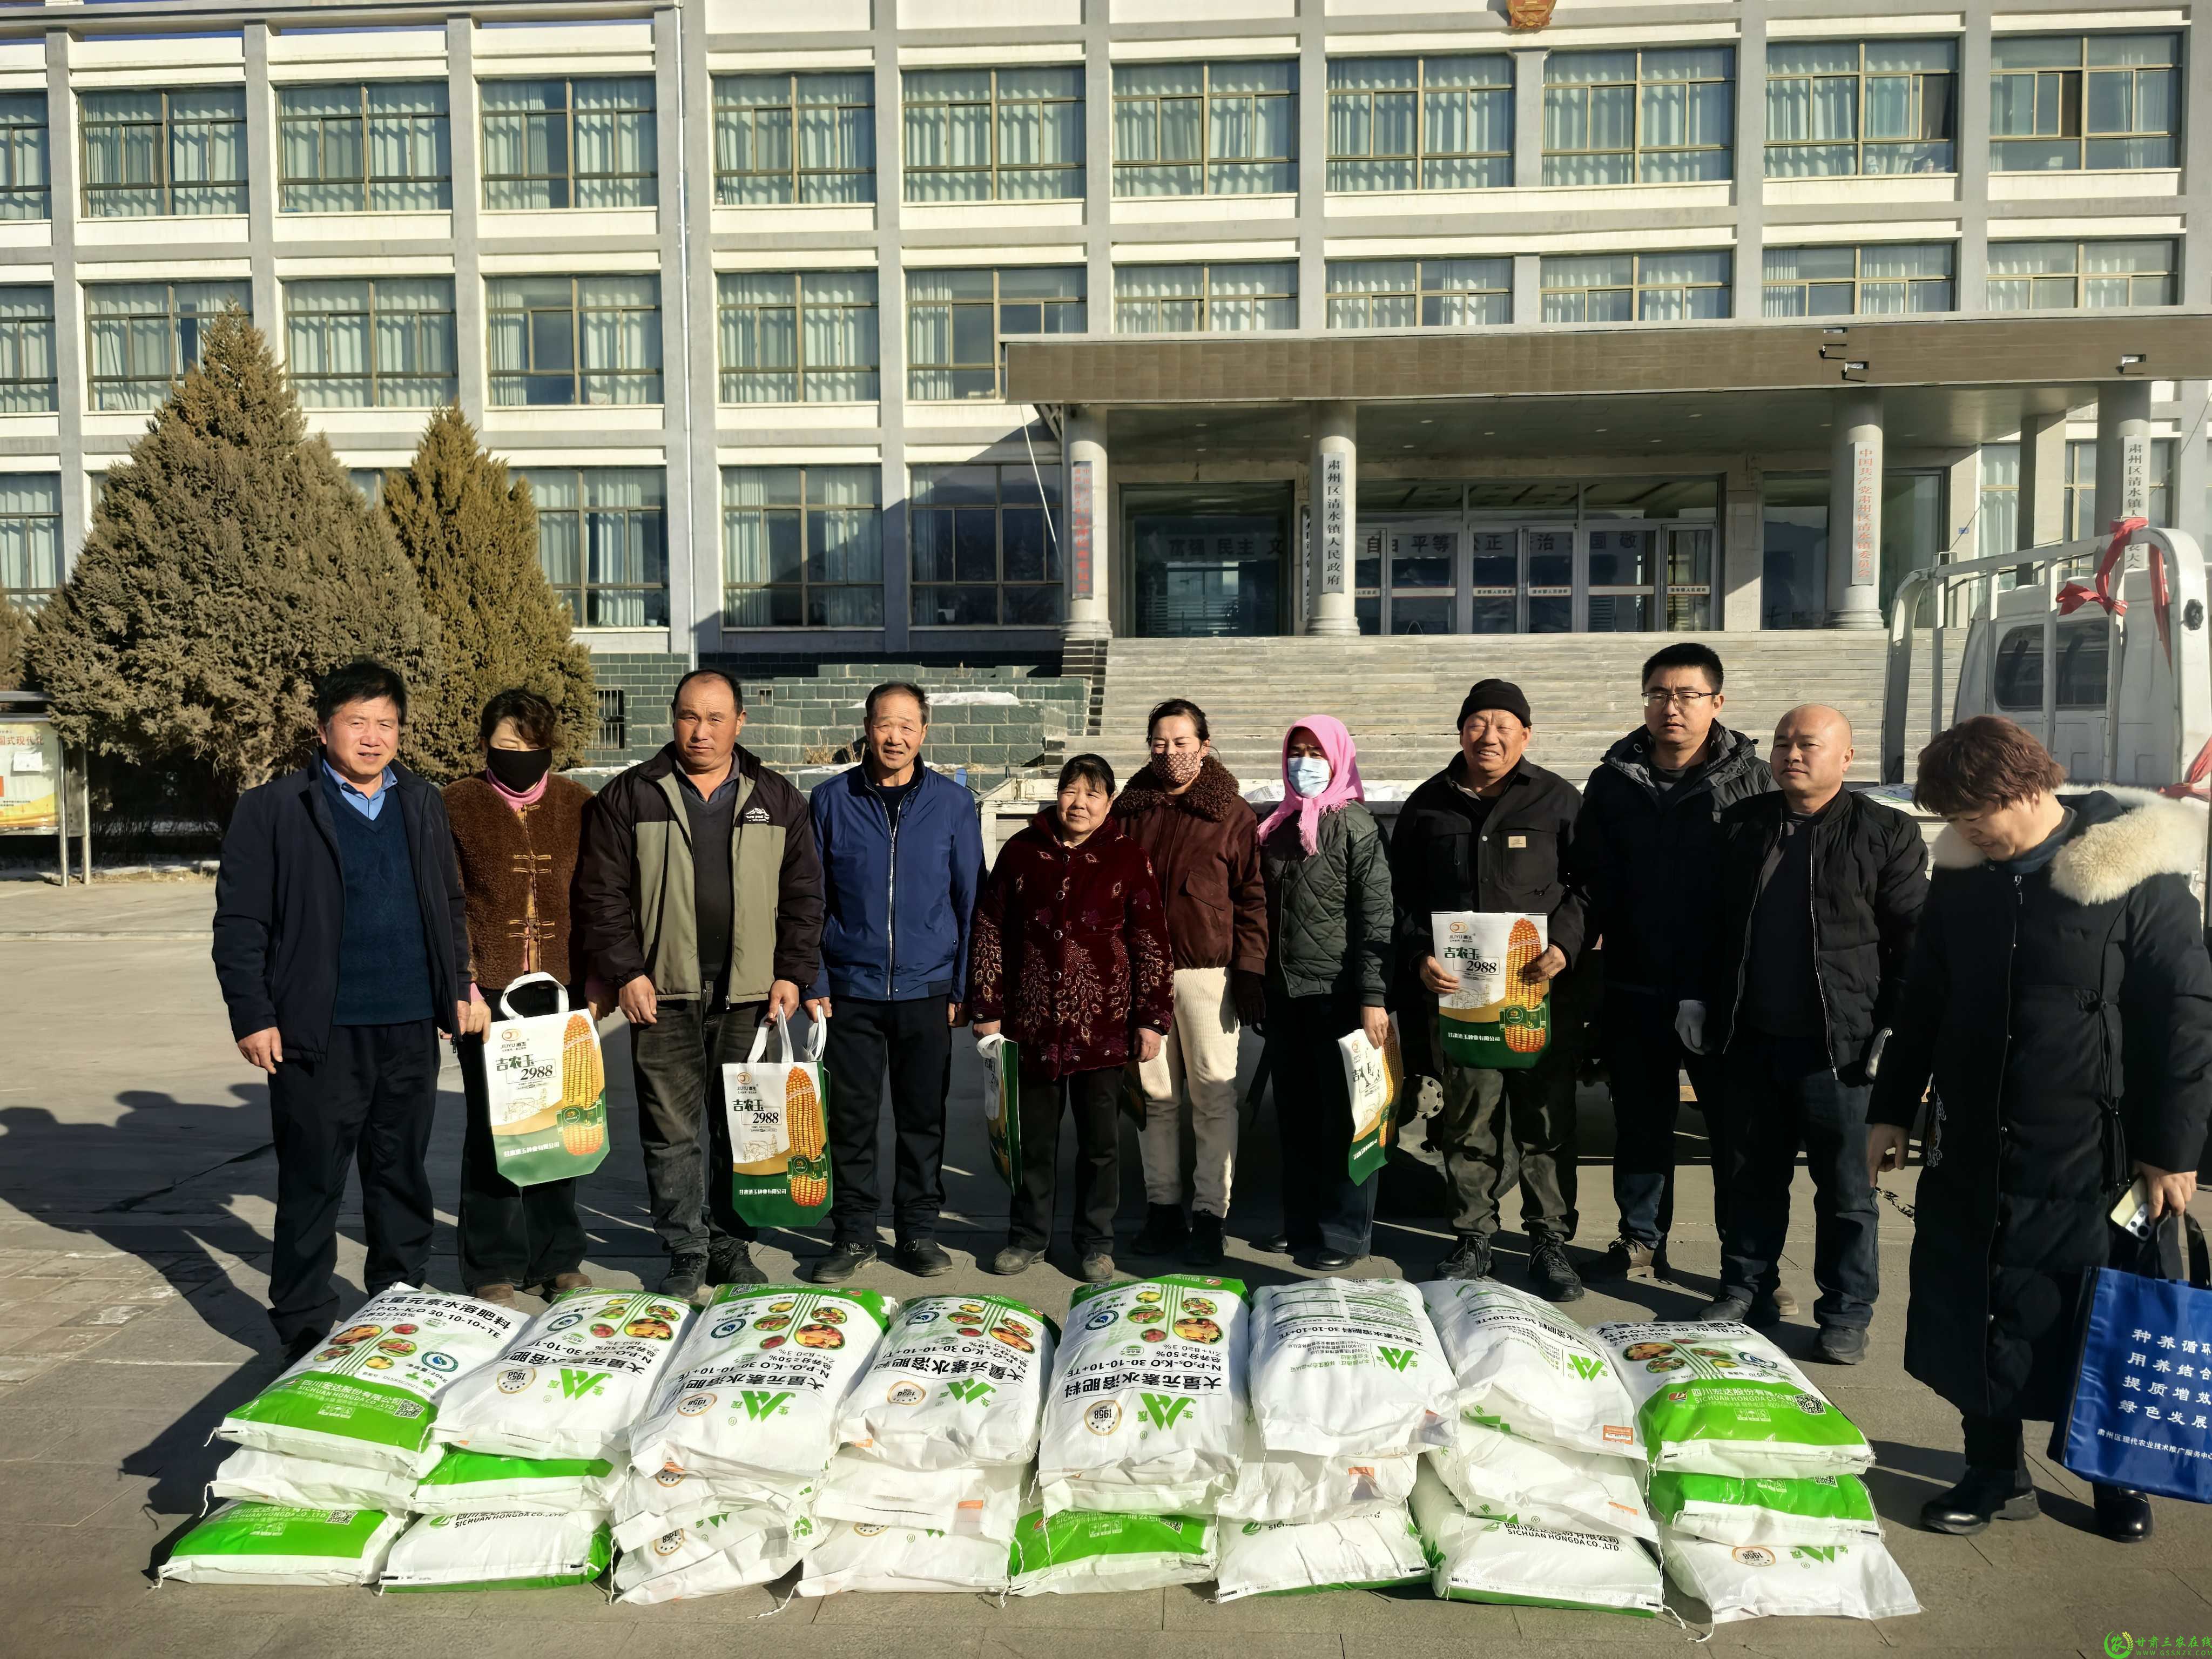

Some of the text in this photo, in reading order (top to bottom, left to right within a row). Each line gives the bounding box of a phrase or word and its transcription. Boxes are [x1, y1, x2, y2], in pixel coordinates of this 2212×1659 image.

[1857, 449, 1873, 577] 中国共产党肃州区清水镇委员会
[1327, 460, 1341, 585] 肃州区清水镇人民政府
[1411, 535, 1449, 553] 平等
[1466, 960, 1497, 973] 2988
[520, 1064, 554, 1081] 2988
[752, 1112, 779, 1124] 2988
[371, 1296, 511, 1330] 大量元素水溶肥料
[2131, 1328, 2212, 1357] 种养循环
[1067, 1359, 1147, 1378] 30-10-10+TE
[2127, 1352, 2212, 1381] 用养结合
[298, 1385, 331, 1396] SICHUAN
[333, 1391, 365, 1401] HONGDA
[302, 1379, 402, 1406] 四川宏达股份有限公司
[1064, 1372, 1222, 1398] 大量元素水溶肥料
[2122, 1374, 2212, 1406] 提质增效
[1695, 1395, 1730, 1404] SICHUAN
[1093, 1408, 1112, 1419] 1958
[2117, 1399, 2209, 1429] 绿色发展
[454, 1516, 491, 1528] SICHUAN
[1507, 1528, 1547, 1539] SICHUAN
[1548, 1534, 1586, 1545] HONGDA
[1742, 1552, 1763, 1561] 1958
